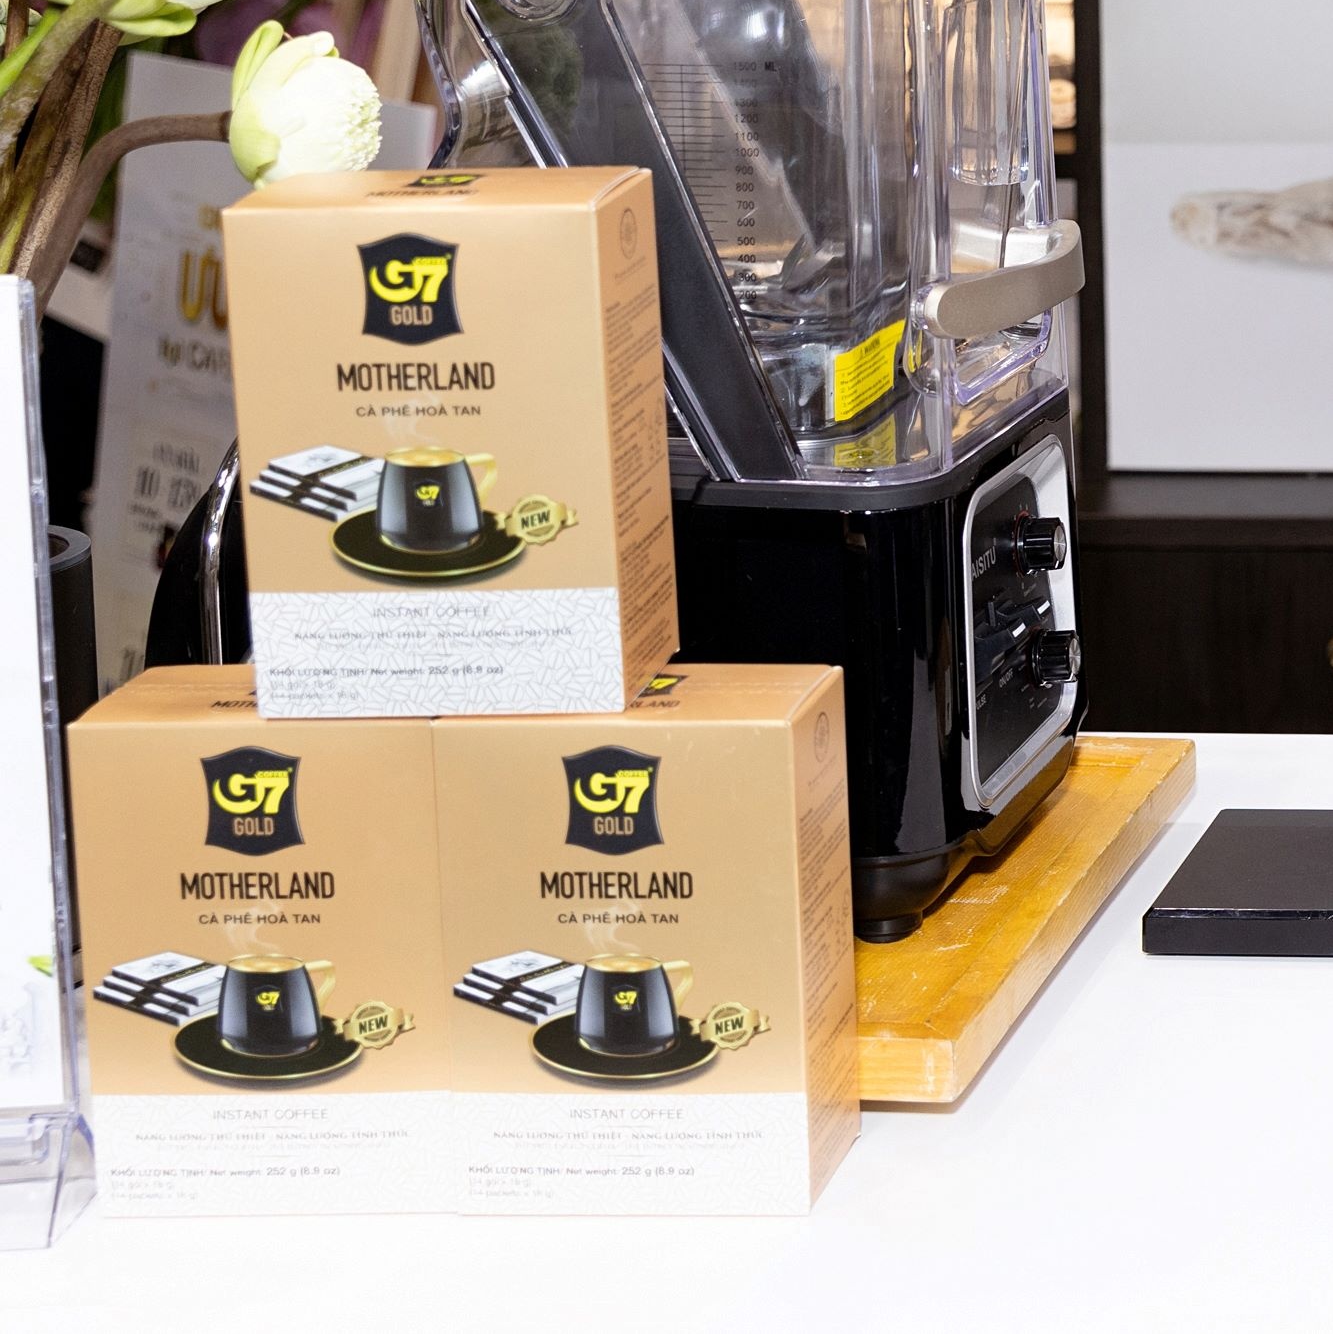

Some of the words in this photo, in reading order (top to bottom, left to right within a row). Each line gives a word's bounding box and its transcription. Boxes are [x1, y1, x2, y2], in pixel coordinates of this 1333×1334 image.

[735, 115, 759, 124] 1200
[736, 132, 759, 141] 1100
[736, 148, 760, 157] 1000
[736, 166, 754, 175] 900
[736, 183, 754, 192] 800
[737, 200, 755, 210] 700
[737, 218, 755, 227] 600
[737, 237, 756, 246] 500
[738, 254, 756, 263] 400
[368, 256, 449, 303] G7
[738, 273, 757, 283] 300
[390, 304, 433, 326] GOLD
[336, 362, 496, 393] MOTHERLAND
[356, 404, 377, 417] CÀ
[381, 404, 410, 417] PHÊ
[415, 403, 448, 417] HOÀ
[453, 406, 481, 416] TAN
[520, 510, 550, 530] NEW
[373, 607, 430, 619] INSTANT
[428, 666, 448, 675] 252
[213, 769, 290, 814] G7
[573, 769, 650, 814] G7
[233, 817, 274, 836] GOLD
[593, 817, 634, 835] GOLD
[180, 872, 335, 900] MOTHERLAND
[540, 871, 694, 900] MOTHERLAND
[199, 913, 219, 925] CÀ
[224, 912, 251, 924] PHÊ
[257, 912, 288, 924] HOÀ
[292, 914, 321, 924] TAN
[558, 912, 577, 924] CÀ
[582, 912, 610, 924] PHÊ
[616, 912, 645, 924] HOÀ
[651, 913, 679, 924] TAN
[358, 1015, 389, 1035] NEW
[714, 1017, 744, 1035] NEW
[213, 1109, 269, 1121] INSTANT
[274, 1108, 329, 1120] COFFEE
[569, 1108, 625, 1120] INSTANT
[630, 1108, 684, 1120] COFFEE
[266, 1166, 287, 1176] 252
[621, 1166, 642, 1176] 252
[679, 1167, 695, 1176] oz)
